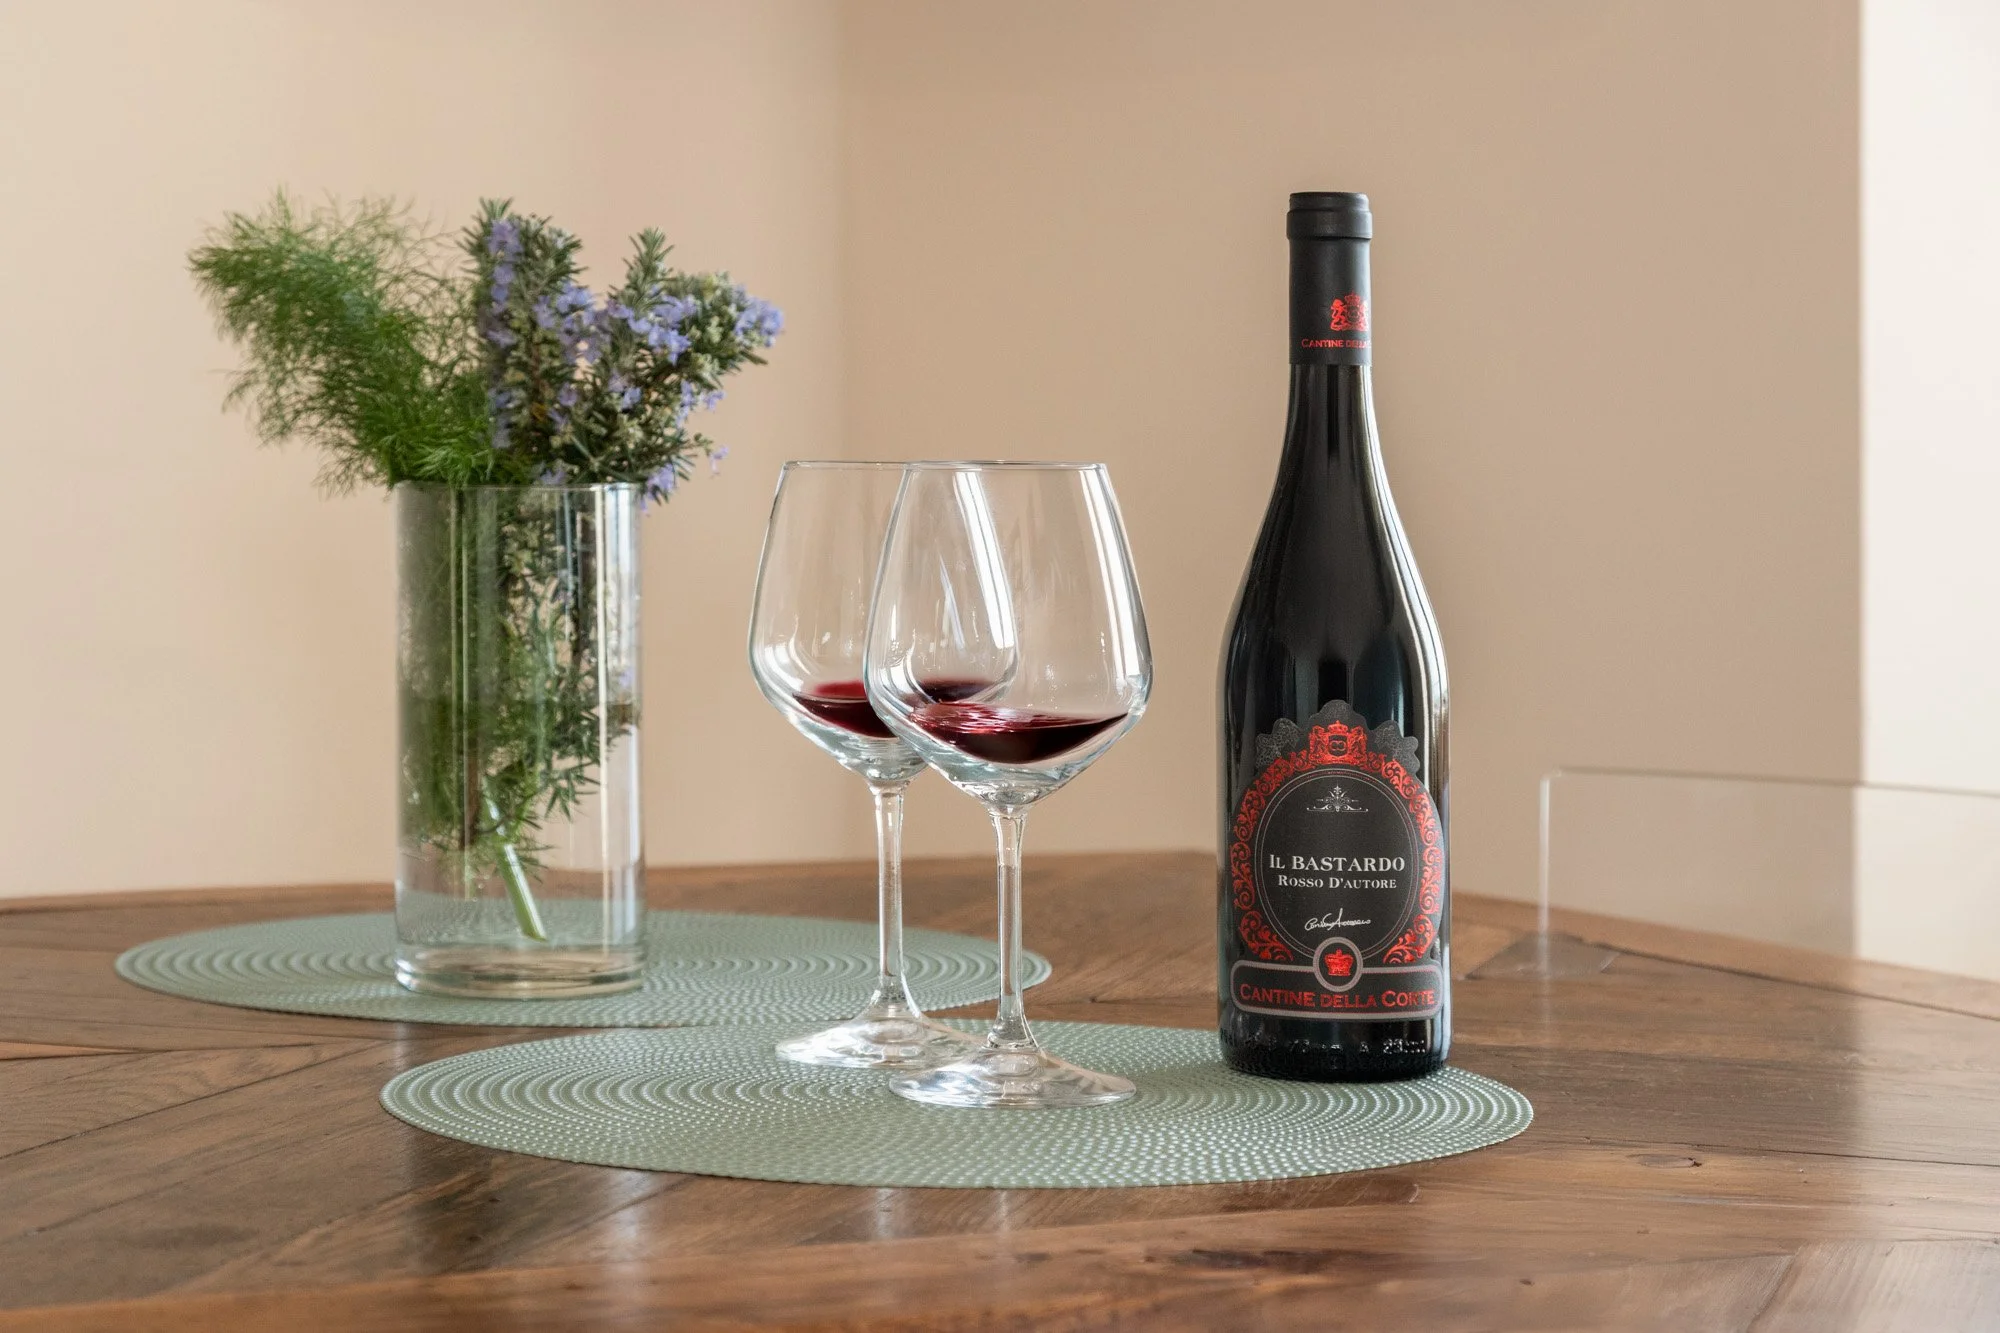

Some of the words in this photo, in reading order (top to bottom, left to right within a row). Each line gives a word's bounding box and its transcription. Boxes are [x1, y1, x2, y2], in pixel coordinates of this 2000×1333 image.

[1301, 338, 1344, 348] CANTINE
[1269, 854, 1285, 869] IL
[1291, 855, 1405, 872] BASTARDO
[1278, 874, 1323, 888] ROSSO
[1329, 877, 1397, 889] D'AUTORE
[1240, 984, 1316, 1007] CANTINE
[1320, 993, 1378, 1008] DELLA
[1381, 989, 1435, 1007] CORTE
